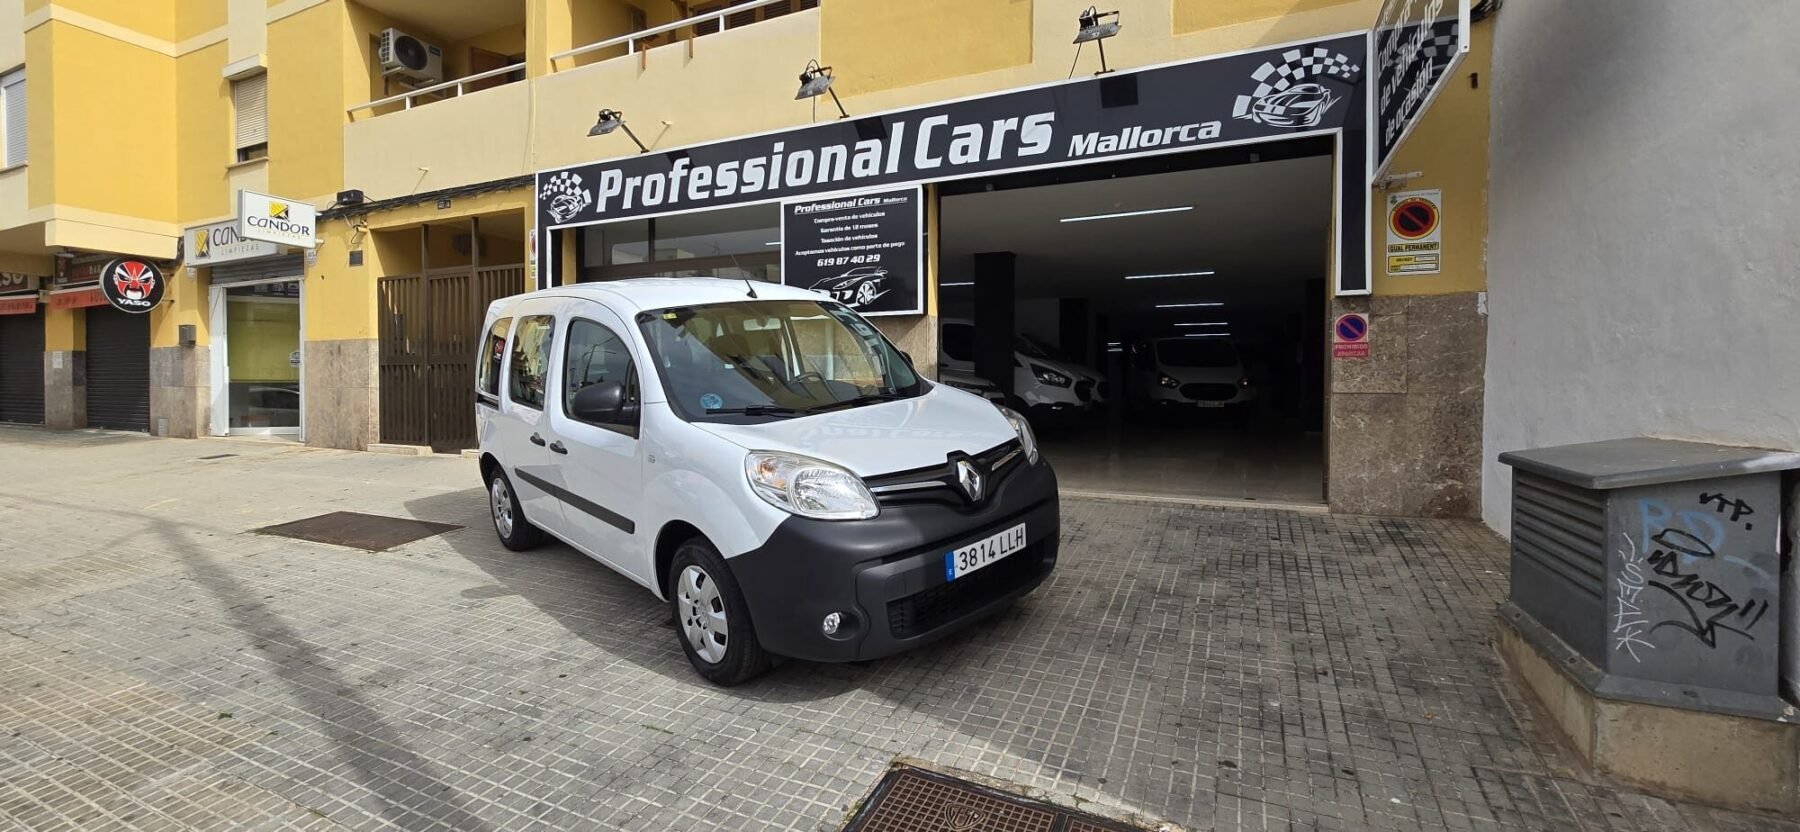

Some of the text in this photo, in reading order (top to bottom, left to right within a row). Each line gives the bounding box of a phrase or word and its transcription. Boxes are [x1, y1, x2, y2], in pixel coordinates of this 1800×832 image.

[1381, 84, 1391, 116] de
[1385, 57, 1433, 147] de ocasión
[596, 111, 1222, 213] Professional Cars Mallorca
[794, 198, 856, 214] Professional
[857, 197, 881, 206] Cars
[221, 243, 259, 256] LIMPIEZAS
[817, 254, 881, 267] 619 87 40 29
[0, 272, 24, 287] SO
[117, 298, 151, 307] YASO
[959, 527, 1023, 571] 3814 LLH
